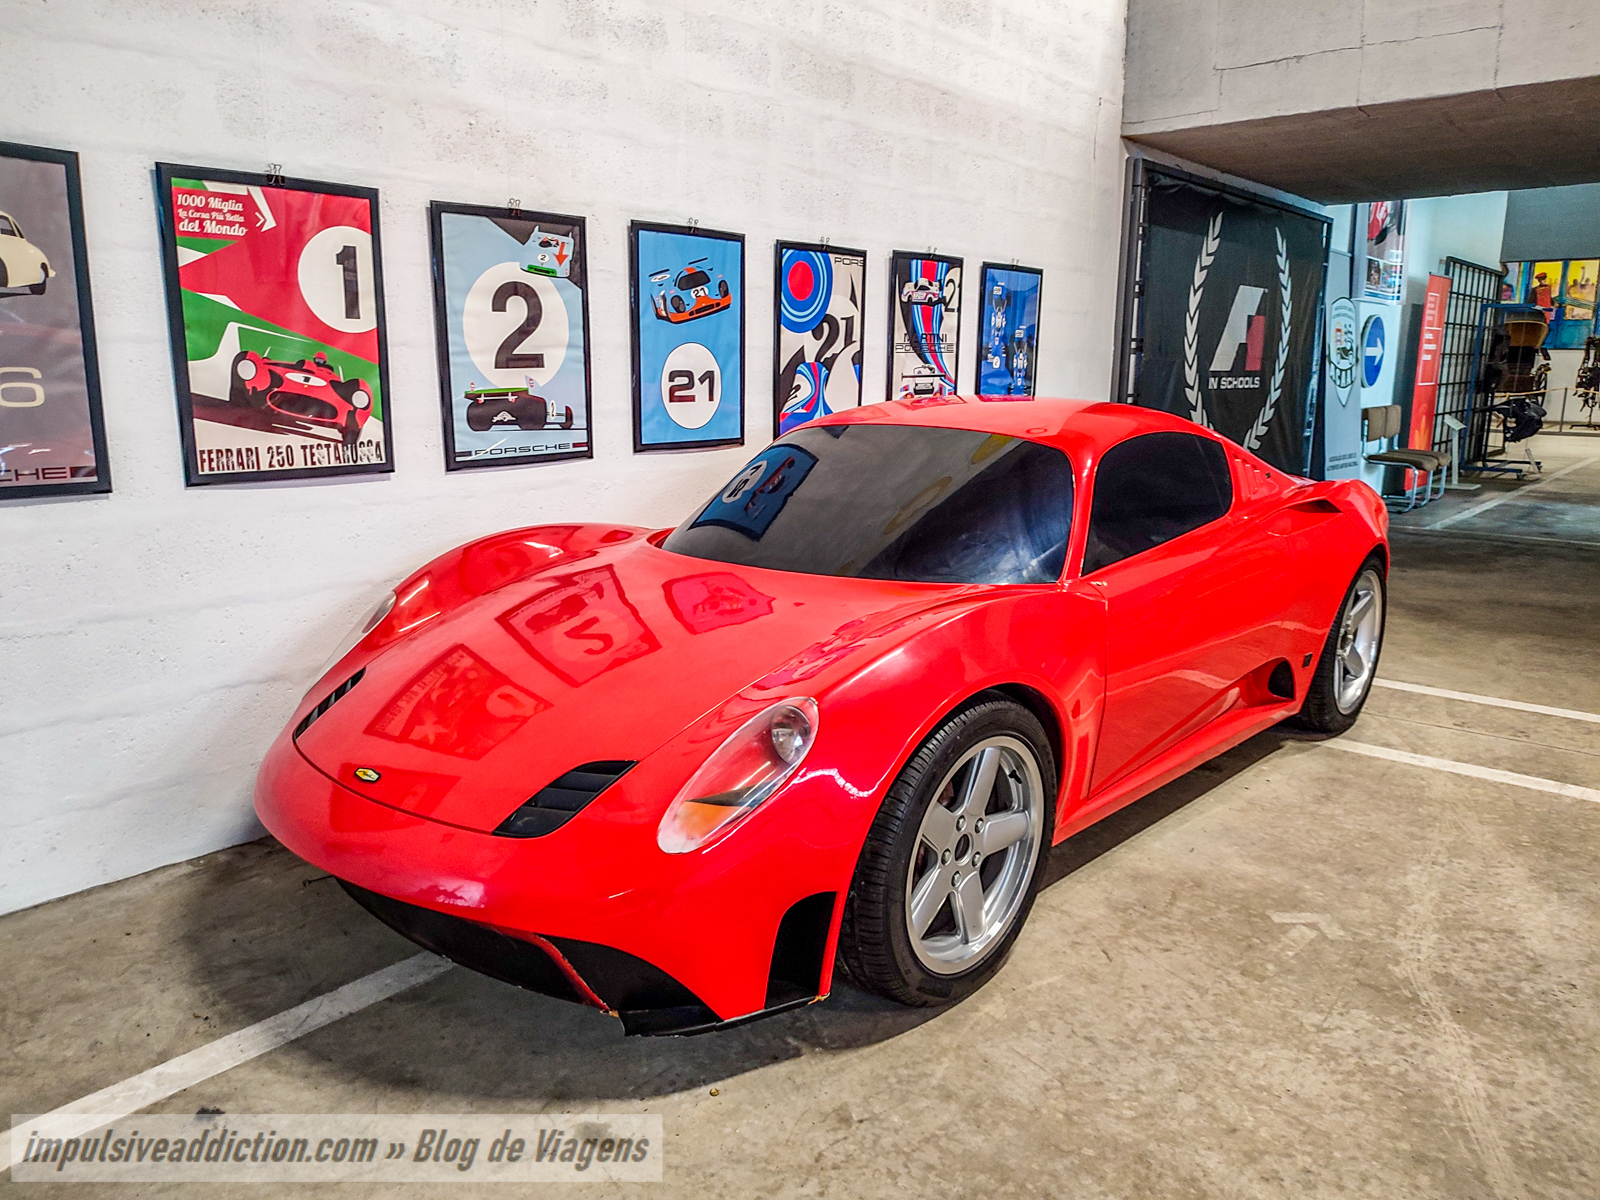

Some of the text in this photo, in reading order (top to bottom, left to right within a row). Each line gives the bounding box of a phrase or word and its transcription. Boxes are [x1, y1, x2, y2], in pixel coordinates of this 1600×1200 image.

[177, 194, 244, 213] 1000 Miglia
[177, 208, 187, 219] La
[188, 209, 211, 219] Corsa
[178, 219, 248, 236] del Mondo
[335, 245, 361, 319] 1
[491, 281, 546, 370] 2
[668, 369, 716, 403] 21
[1208, 376, 1261, 390] IN SCHOOLS
[199, 446, 261, 472] FERRARI
[266, 444, 295, 468] 250
[475, 442, 571, 456] PORSCHE
